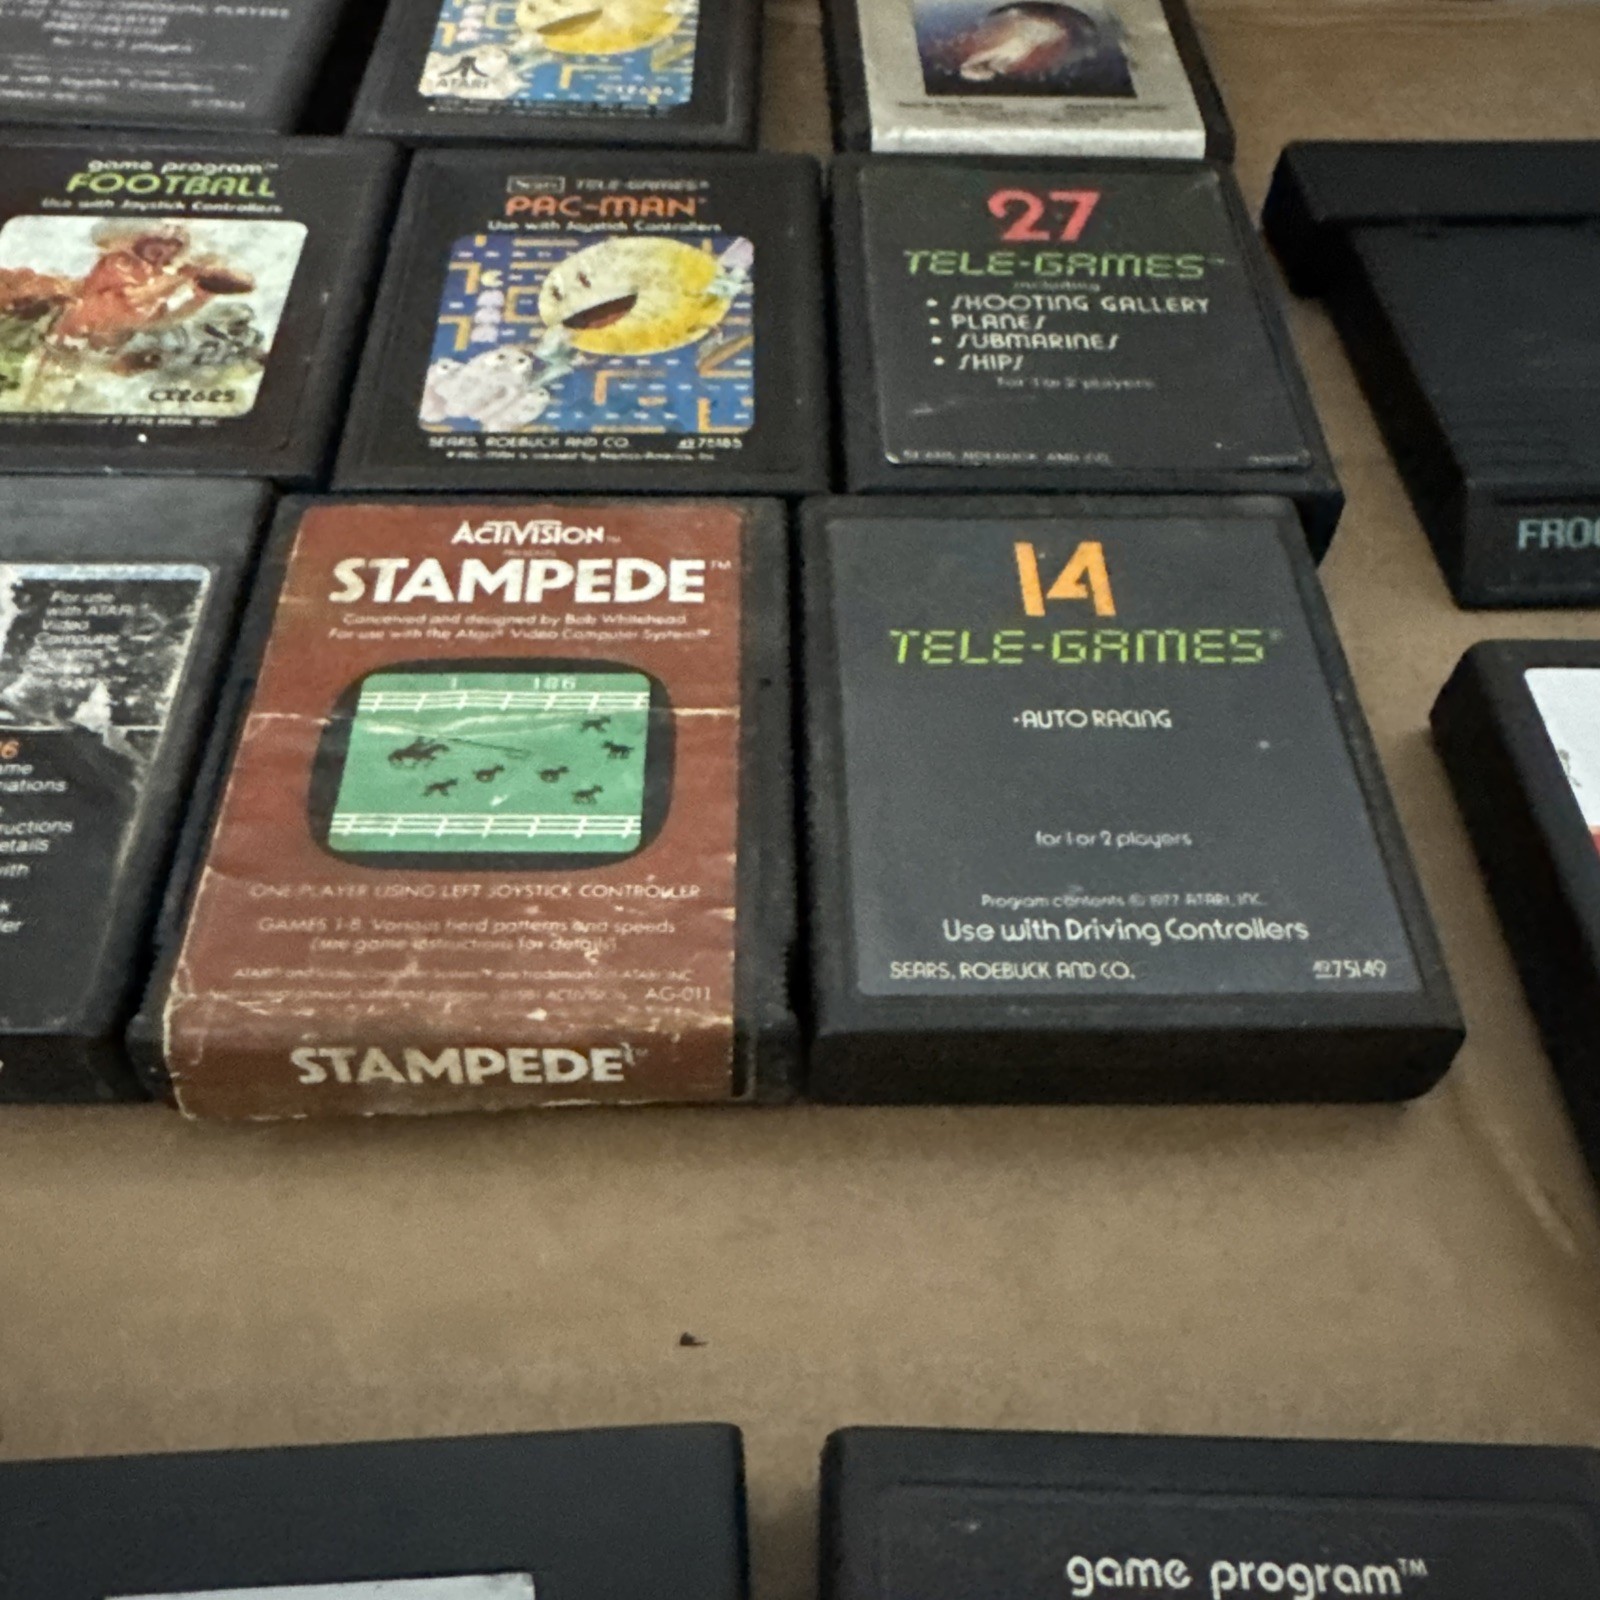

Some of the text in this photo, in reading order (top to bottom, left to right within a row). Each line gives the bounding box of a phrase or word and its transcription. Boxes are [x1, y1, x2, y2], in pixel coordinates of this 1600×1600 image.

[88, 160, 153, 173] game
[65, 172, 276, 198] FOOTBALL
[78, 200, 115, 209] with
[120, 200, 186, 211] Joystick
[191, 201, 283, 213] Controllers
[505, 195, 697, 217] PAC-MAN
[987, 188, 1101, 243] 27
[903, 250, 1206, 279] TELE-GAMES
[951, 294, 1210, 315] SHOOTING GALLERY
[951, 314, 1047, 331] PLANES
[956, 333, 1120, 350] SUBMARINES
[957, 354, 1025, 372] SHIPS
[1013, 541, 1117, 617] 14
[429, 614, 461, 625] and
[540, 614, 560, 626] by
[564, 613, 597, 625] Bob
[510, 629, 558, 640] Video
[889, 629, 1265, 664] TELE-GAMES
[1021, 709, 1173, 729] AUTO RACING
[1076, 833, 1096, 846] or
[1100, 830, 1112, 846] 2
[1116, 831, 1193, 849] players
[301, 884, 368, 897] PLAYER
[375, 884, 436, 898] USING
[443, 884, 481, 897] LEFT
[488, 884, 572, 898] JOYSTICK
[981, 894, 1049, 909] Program
[614, 920, 675, 935] speeds
[943, 917, 1310, 946] Use with Driving Controllers
[960, 961, 1050, 979] ROEBUCK
[1057, 961, 1096, 979] AND
[1101, 961, 1136, 979] CO.
[1066, 1555, 1192, 1597] game
